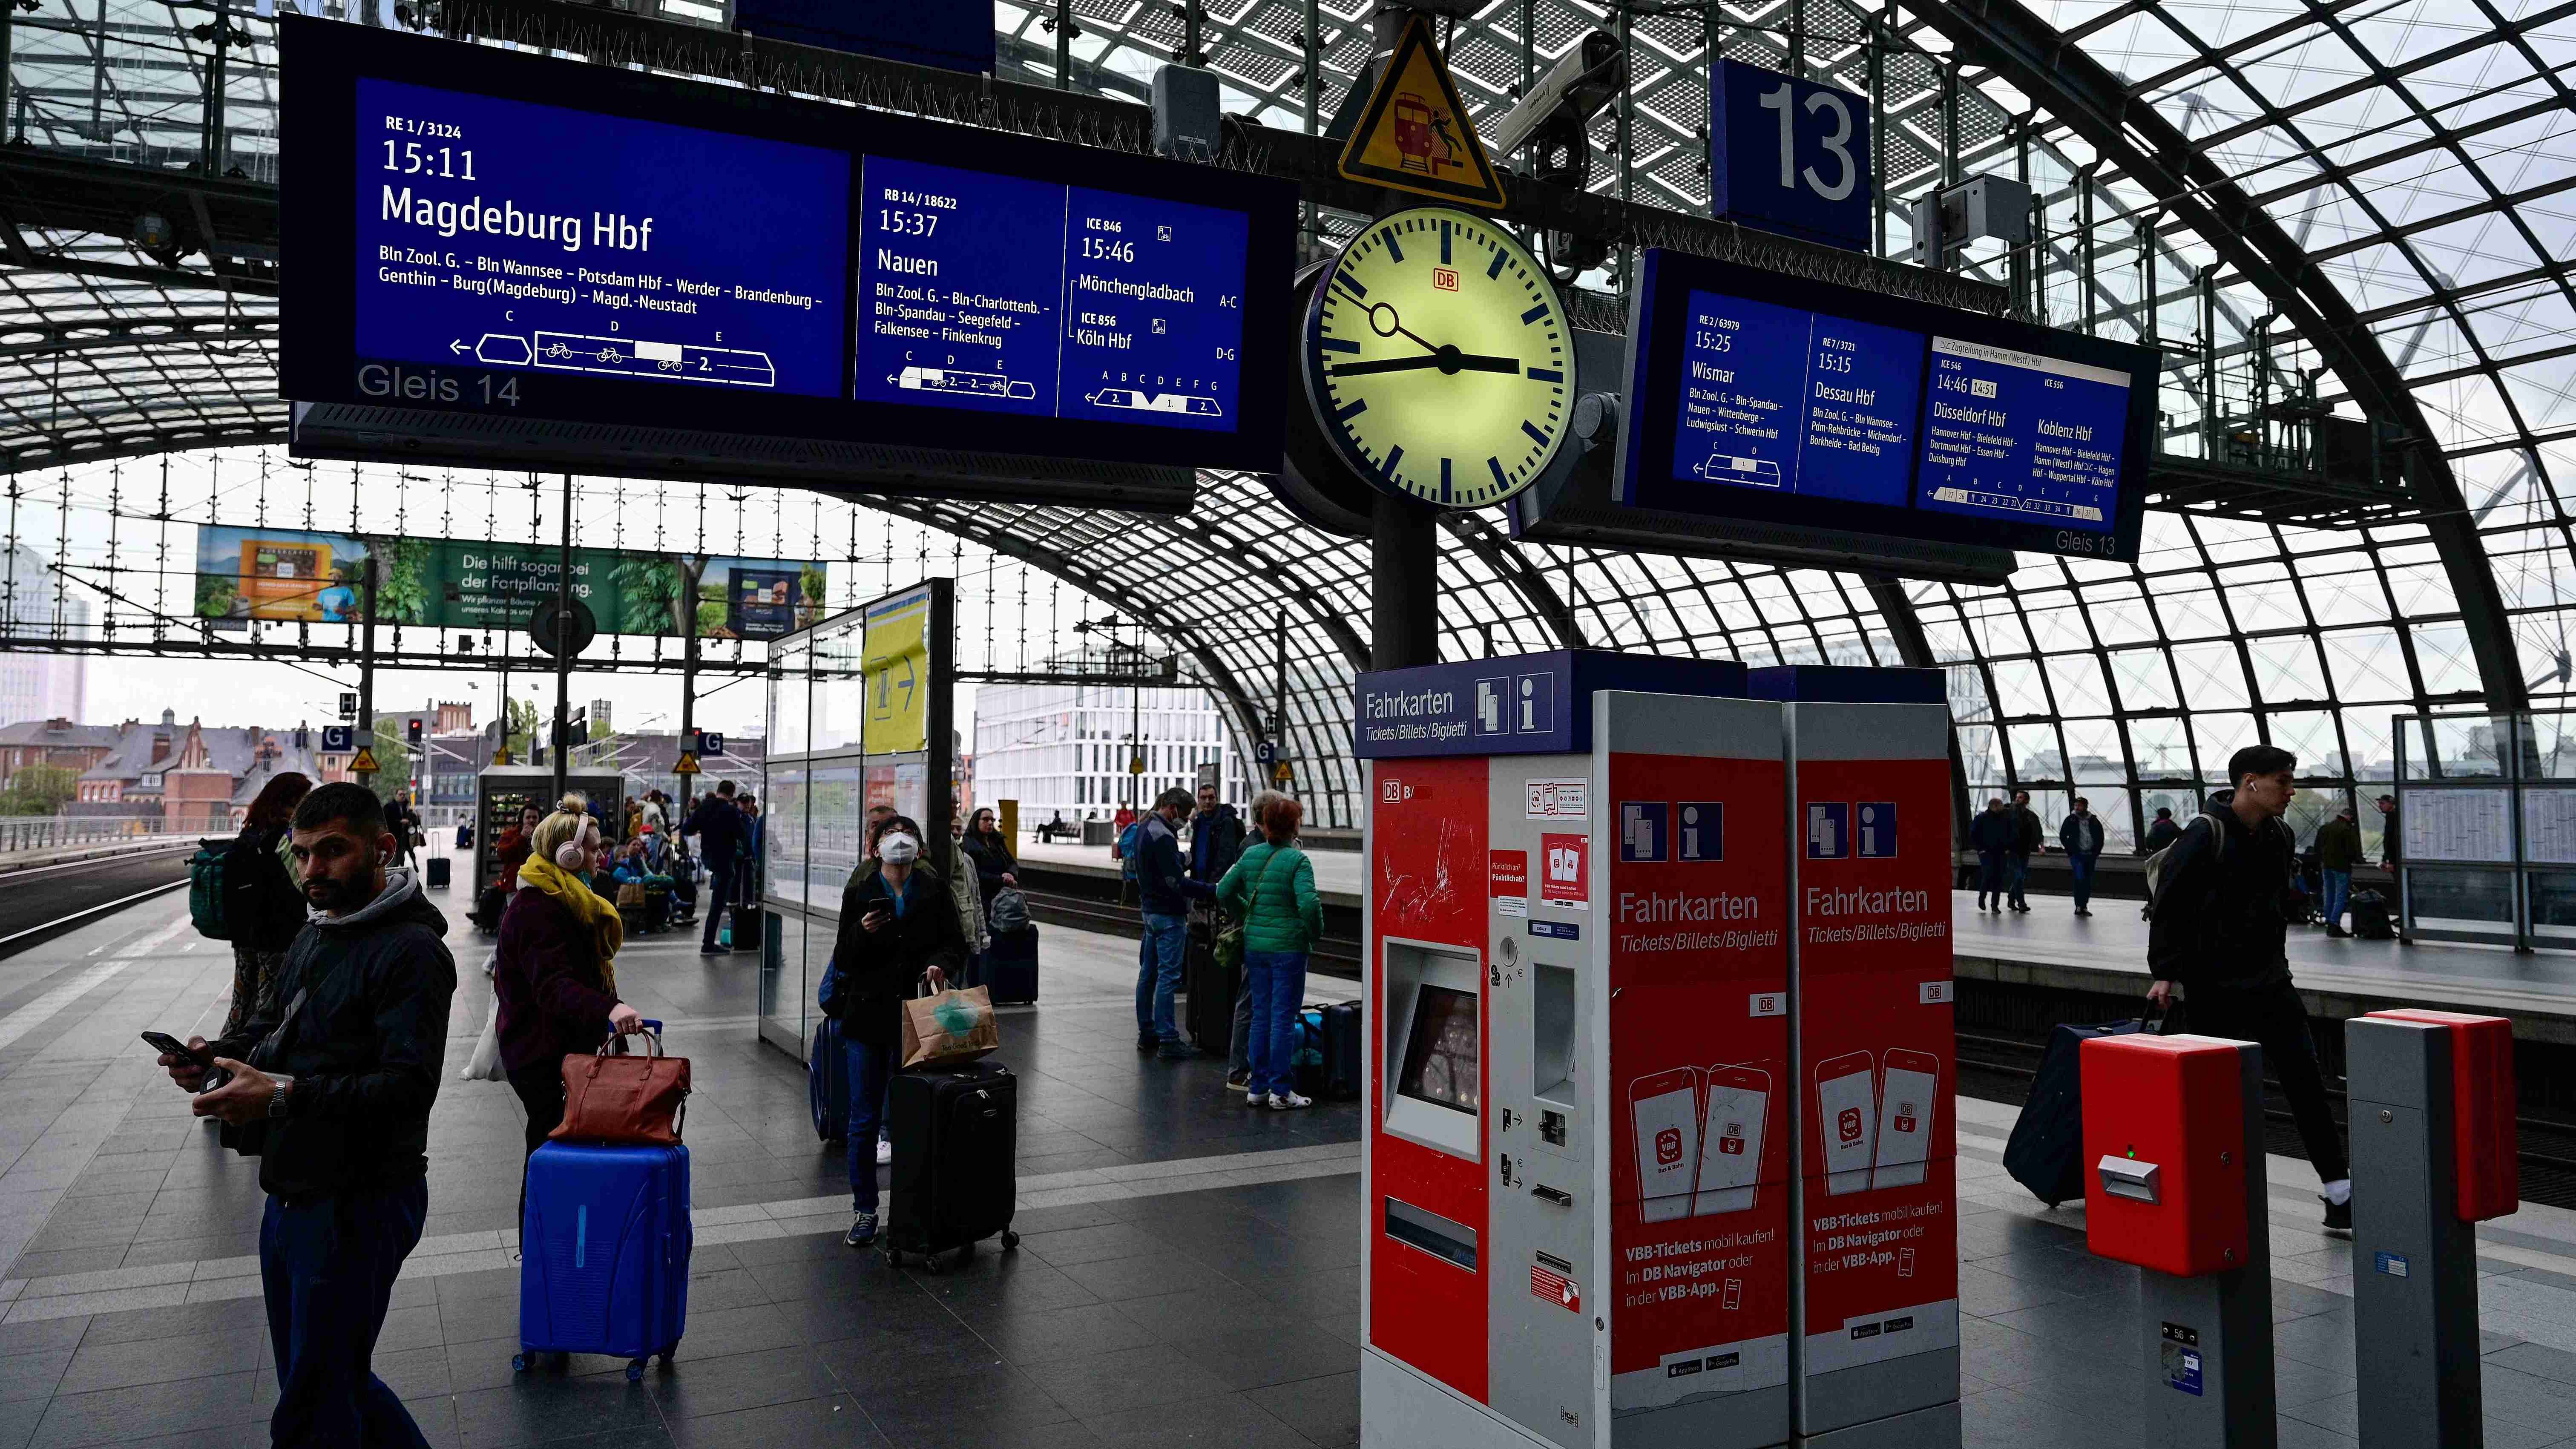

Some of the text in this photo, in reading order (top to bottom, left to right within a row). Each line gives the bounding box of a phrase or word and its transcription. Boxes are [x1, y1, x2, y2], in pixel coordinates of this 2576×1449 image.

[386, 116, 403, 131] RE
[1760, 82, 1855, 201] 13
[384, 140, 475, 181] 15:11
[885, 188, 899, 201] RB
[902, 191, 915, 204] 14
[382, 185, 653, 252] Magdeburg Hbf
[880, 209, 937, 237] 15:37
[1087, 217, 1121, 233] ICE 846
[1082, 237, 1134, 263] 15:46
[878, 248, 937, 276] Nauen
[380, 245, 811, 310] Bln Zool. G. Bln Wannsee Potsdam Hbf Werder Brandenburg
[1435, 270, 1457, 290] DB
[379, 267, 697, 314] Genthin Burg(Magdeburg) Magd.-Neustadt
[876, 282, 1040, 314] Bln Zool. G. Bln-Charlottenb.
[1080, 274, 1193, 303] Mönchengladbach
[1219, 295, 1237, 308] A-C
[876, 302, 1011, 329] Bln-Spandau Seegefeld
[1081, 312, 1116, 327] ICE 856
[1699, 315, 1708, 325] RE
[875, 320, 1002, 349] Falkensee Finkenkrug
[1077, 328, 1132, 349] Köln Hbf
[1695, 331, 1731, 352] 15:25
[1823, 337, 1831, 347] RE
[1216, 347, 1234, 360] D-G
[1819, 353, 1852, 373] 15:15
[1951, 341, 2042, 367] Zugteilung in Hamm (Westf) Hbf
[1693, 361, 1735, 383] Wismar
[1941, 359, 1961, 371] ICE 546
[358, 364, 520, 406] Gleis 14
[1815, 381, 1875, 406] Dessau Hbf
[1938, 374, 1967, 393] 14:46
[1973, 382, 1994, 395] 14:51
[2044, 378, 2063, 389] ICE 556
[1690, 388, 1777, 411] Bln Zool. G. Bln-Spandau
[1688, 402, 1759, 424] Nauen Wittenberge
[1813, 407, 1893, 428] Bln Zool. G. Bln Wannsee
[1934, 402, 2006, 427] Düsseldorf Hbf
[1687, 416, 1779, 439] Ludwigslust Schwerin Hbf
[1811, 421, 1902, 443] Pdm-Rehbrücke Michendorf
[1932, 426, 2013, 447] Hannover Hbf Bielefeld Hbf
[2038, 419, 2093, 441] Koblenz Hbf
[1810, 434, 1880, 456] Borkheide Bad Belzig
[1930, 439, 2005, 459] Dortmund Hbf Essen Hbf
[1929, 452, 1966, 467] Duisburg Hbf
[2056, 530, 2115, 555] Gleis 13
[463, 554, 488, 569] Die
[492, 555, 517, 571] hilft
[462, 572, 592, 598] der Fortpflanzng.
[341, 694, 354, 710] H
[1366, 688, 1452, 719] Fahrkarten
[1267, 719, 1275, 731] H
[326, 726, 343, 746] G
[705, 733, 721, 751] G
[1257, 743, 1268, 759] G
[1384, 782, 1399, 801] DB
[1620, 891, 1757, 923] Fahrkarten
[1808, 886, 1927, 916] Fahrkarten
[1928, 986, 1941, 999] DB
[1759, 997, 1774, 1011] DB
[1728, 1124, 1740, 1135] DB
[1662, 1141, 1676, 1151] VBB
[1625, 1228, 1774, 1262] VBB-Tickets mobil kaufen!
[1627, 1254, 1753, 1285] Im DB Navigator oder
[1626, 1282, 1719, 1307] in der VBB-App.
[2174, 1329, 2184, 1340] 56
